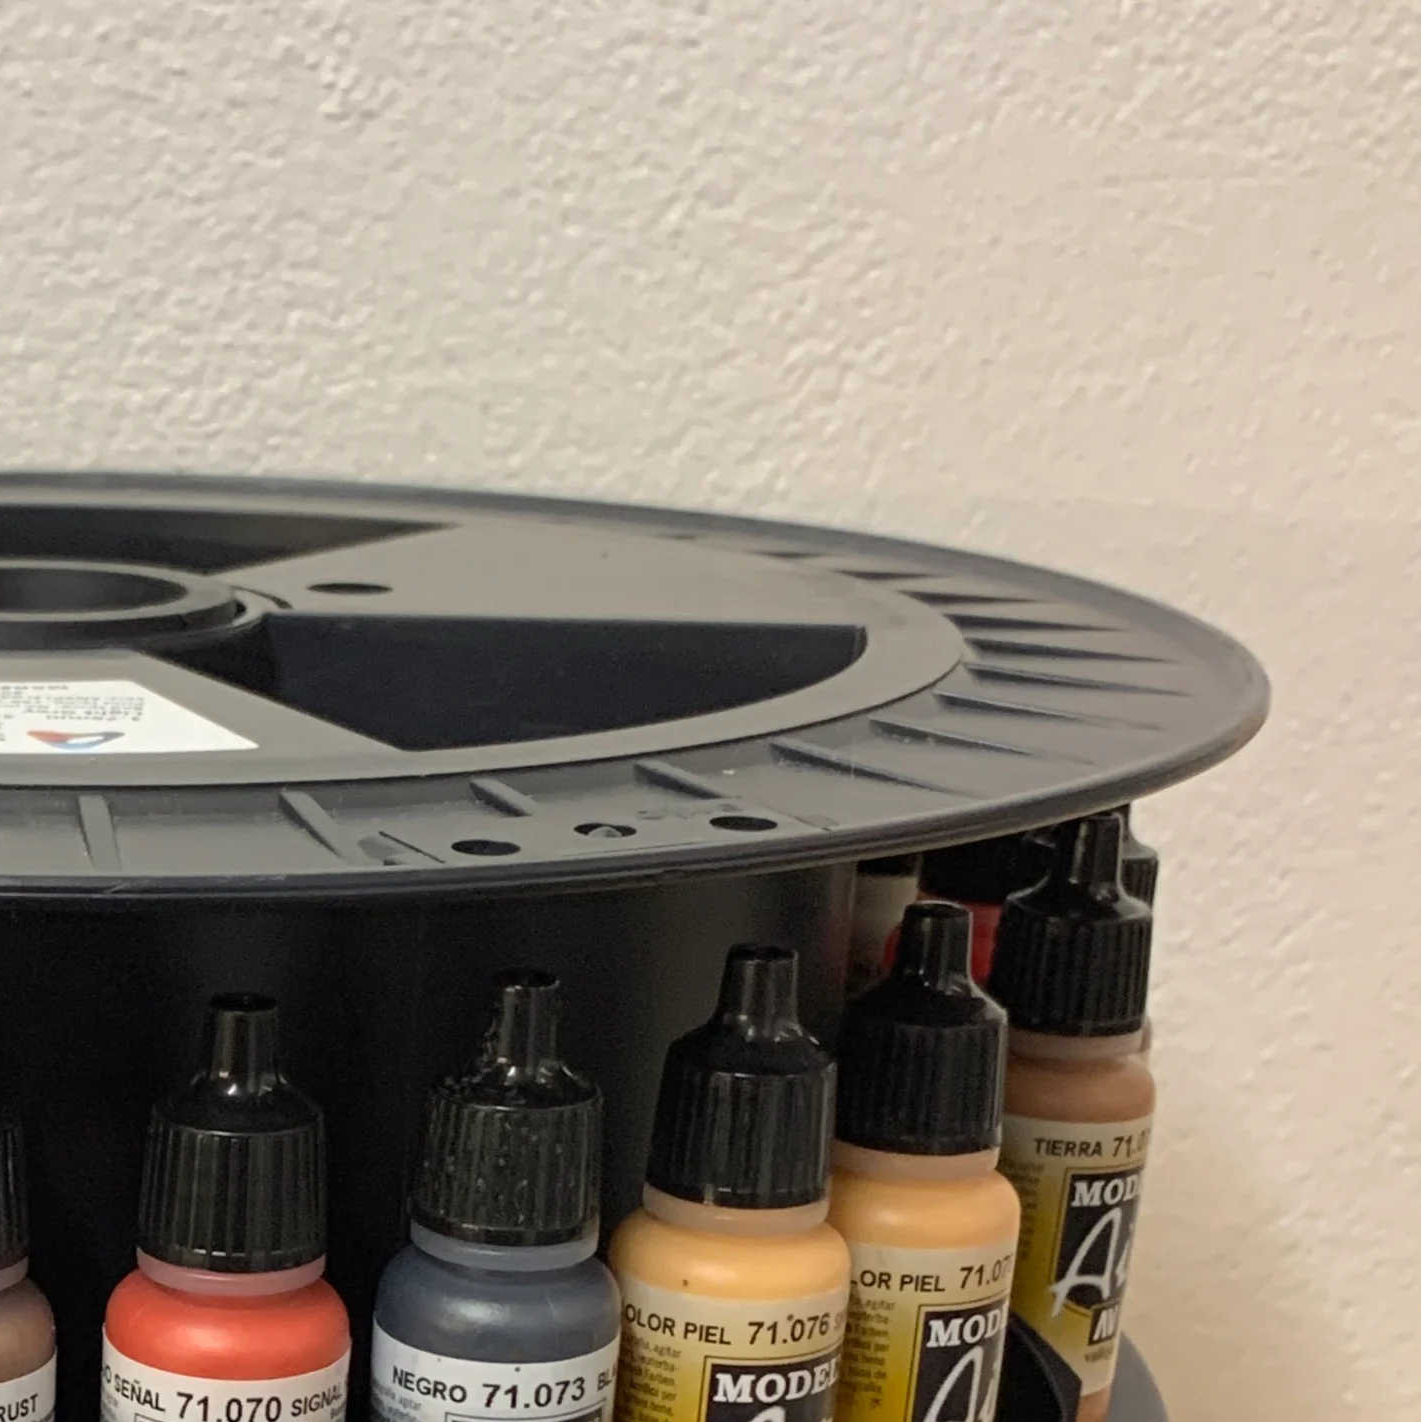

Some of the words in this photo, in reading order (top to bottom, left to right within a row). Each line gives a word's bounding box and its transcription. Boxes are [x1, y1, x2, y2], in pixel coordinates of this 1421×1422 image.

[1035, 1137, 1103, 1158] TIERRA
[899, 1271, 946, 1293] PIEL
[959, 1259, 1012, 1291] 71.07
[683, 1321, 732, 1346] PIEL
[746, 1312, 831, 1346] 71.076
[113, 1371, 166, 1413] SEÑAL
[392, 1365, 468, 1404] NEGRO
[482, 1376, 586, 1410] 71.073
